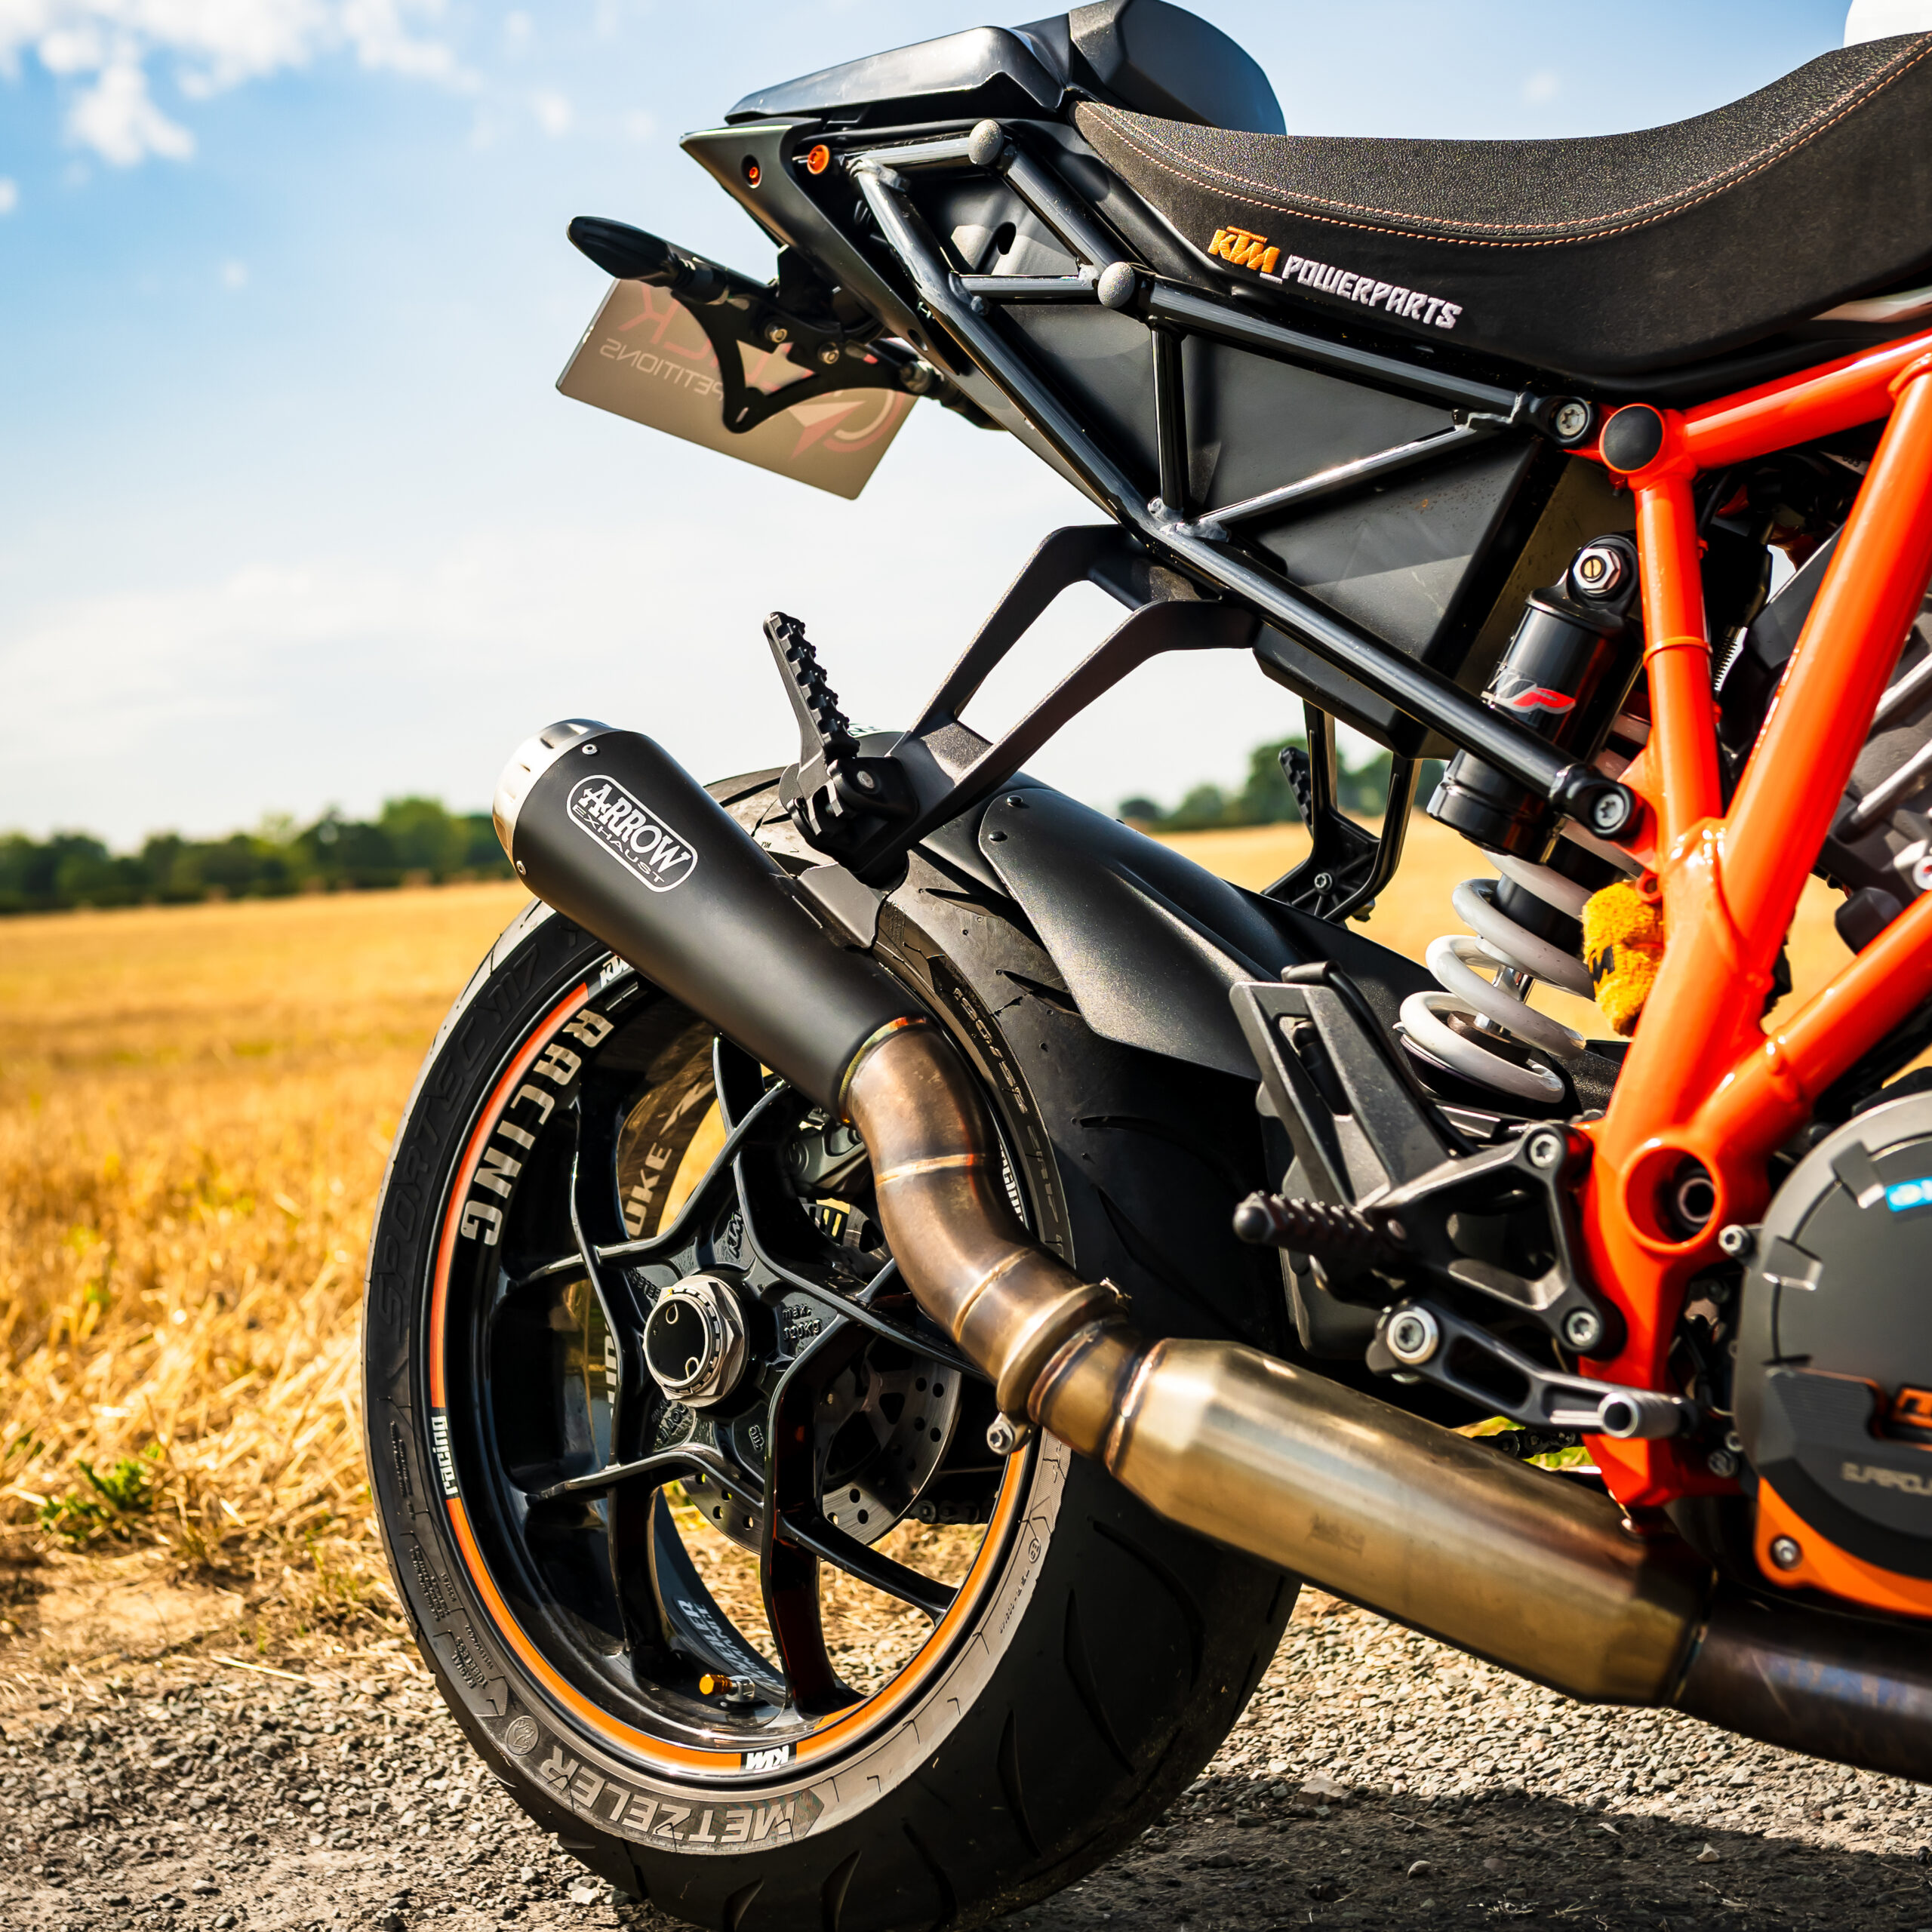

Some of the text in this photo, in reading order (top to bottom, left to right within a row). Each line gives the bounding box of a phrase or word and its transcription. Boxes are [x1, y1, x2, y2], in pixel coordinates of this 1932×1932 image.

[1208, 226, 1281, 273] KTM
[572, 804, 665, 884] EXHAUST
[578, 783, 691, 873] ARROW
[460, 1009, 614, 1247] RACING
[628, 1142, 673, 1238] UKE
[430, 1415, 459, 1496] racing
[540, 1745, 796, 1844] METZELER
[746, 1745, 789, 1774] KTM
